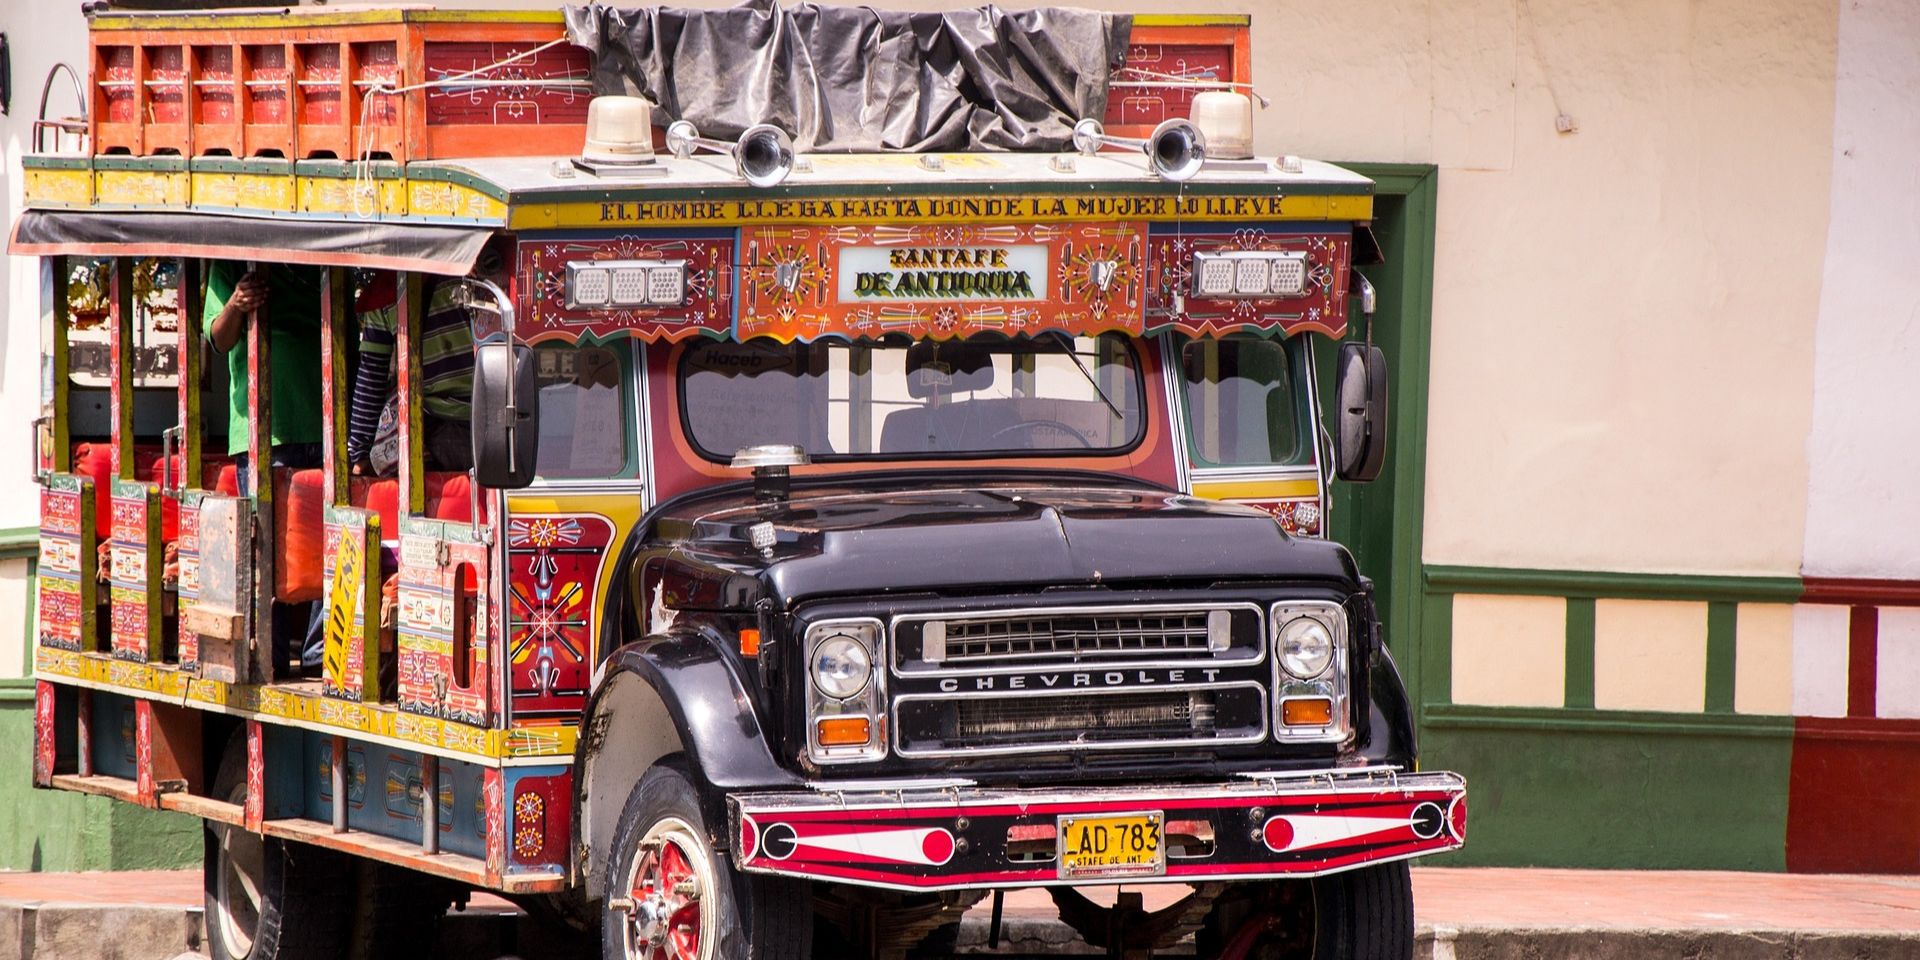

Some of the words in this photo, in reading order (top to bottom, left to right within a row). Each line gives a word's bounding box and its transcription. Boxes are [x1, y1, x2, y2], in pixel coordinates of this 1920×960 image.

[600, 202, 632, 221] EL
[841, 199, 922, 218] HASTA
[928, 199, 1025, 217] DONDE
[1031, 198, 1068, 217] LA
[1075, 197, 1166, 216] MUJER
[1205, 197, 1284, 216] LLEVE
[889, 248, 1009, 269] SANTAFE
[854, 271, 894, 298] DE
[893, 270, 1035, 298] ANTIOQUIA
[705, 350, 762, 368] Haceb
[939, 668, 1220, 692] CHEVROLET
[1114, 822, 1160, 852] 783
[1076, 856, 1103, 866] STAFE
[1109, 855, 1119, 865] DE
